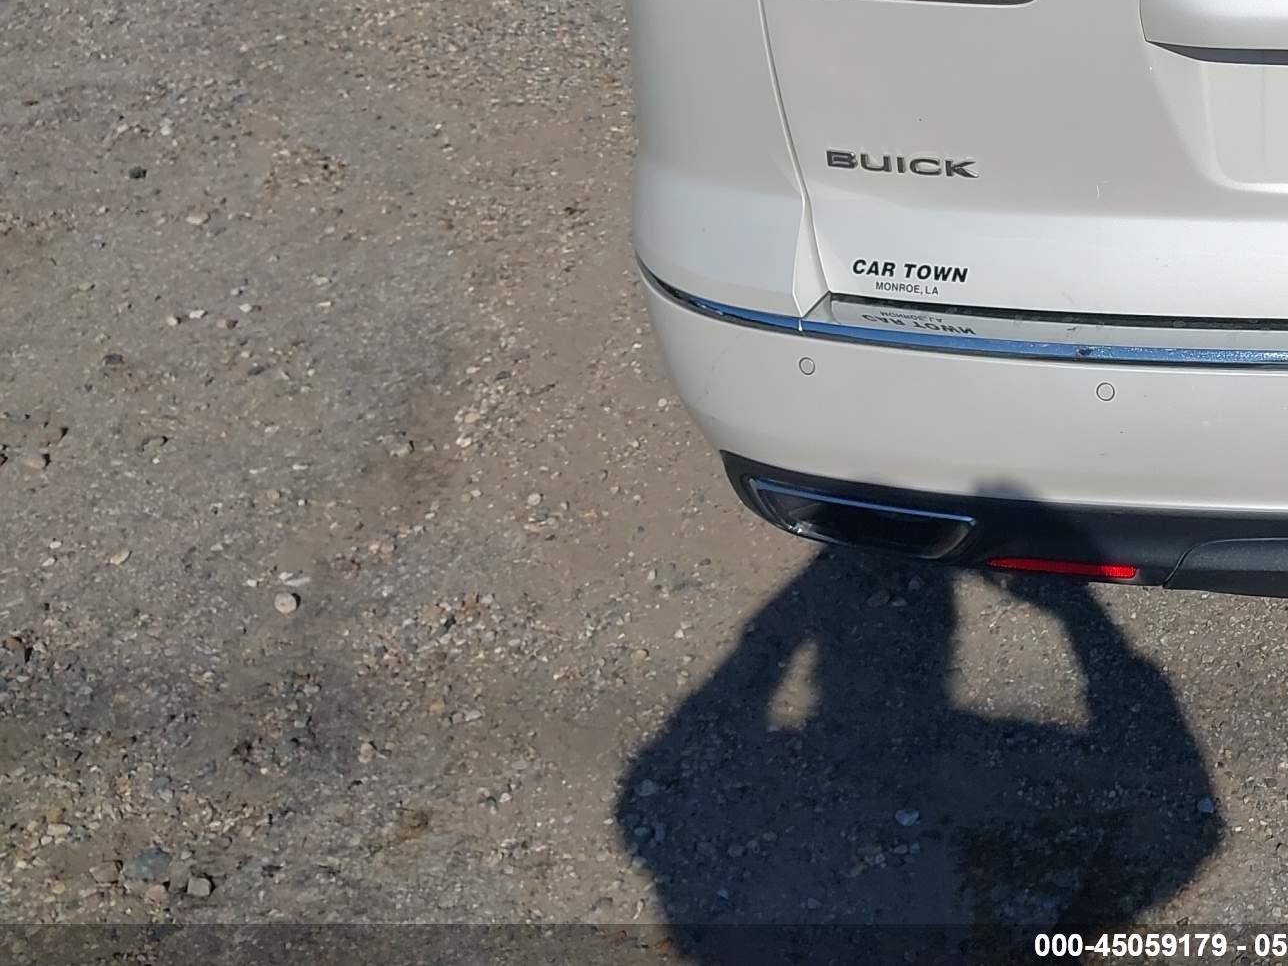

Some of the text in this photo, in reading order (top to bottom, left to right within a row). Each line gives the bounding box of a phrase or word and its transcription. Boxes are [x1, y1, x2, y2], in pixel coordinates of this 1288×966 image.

[826, 150, 979, 178] BUICK
[852, 259, 969, 283] CAR TOWN
[875, 281, 939, 295] MONROE, LA
